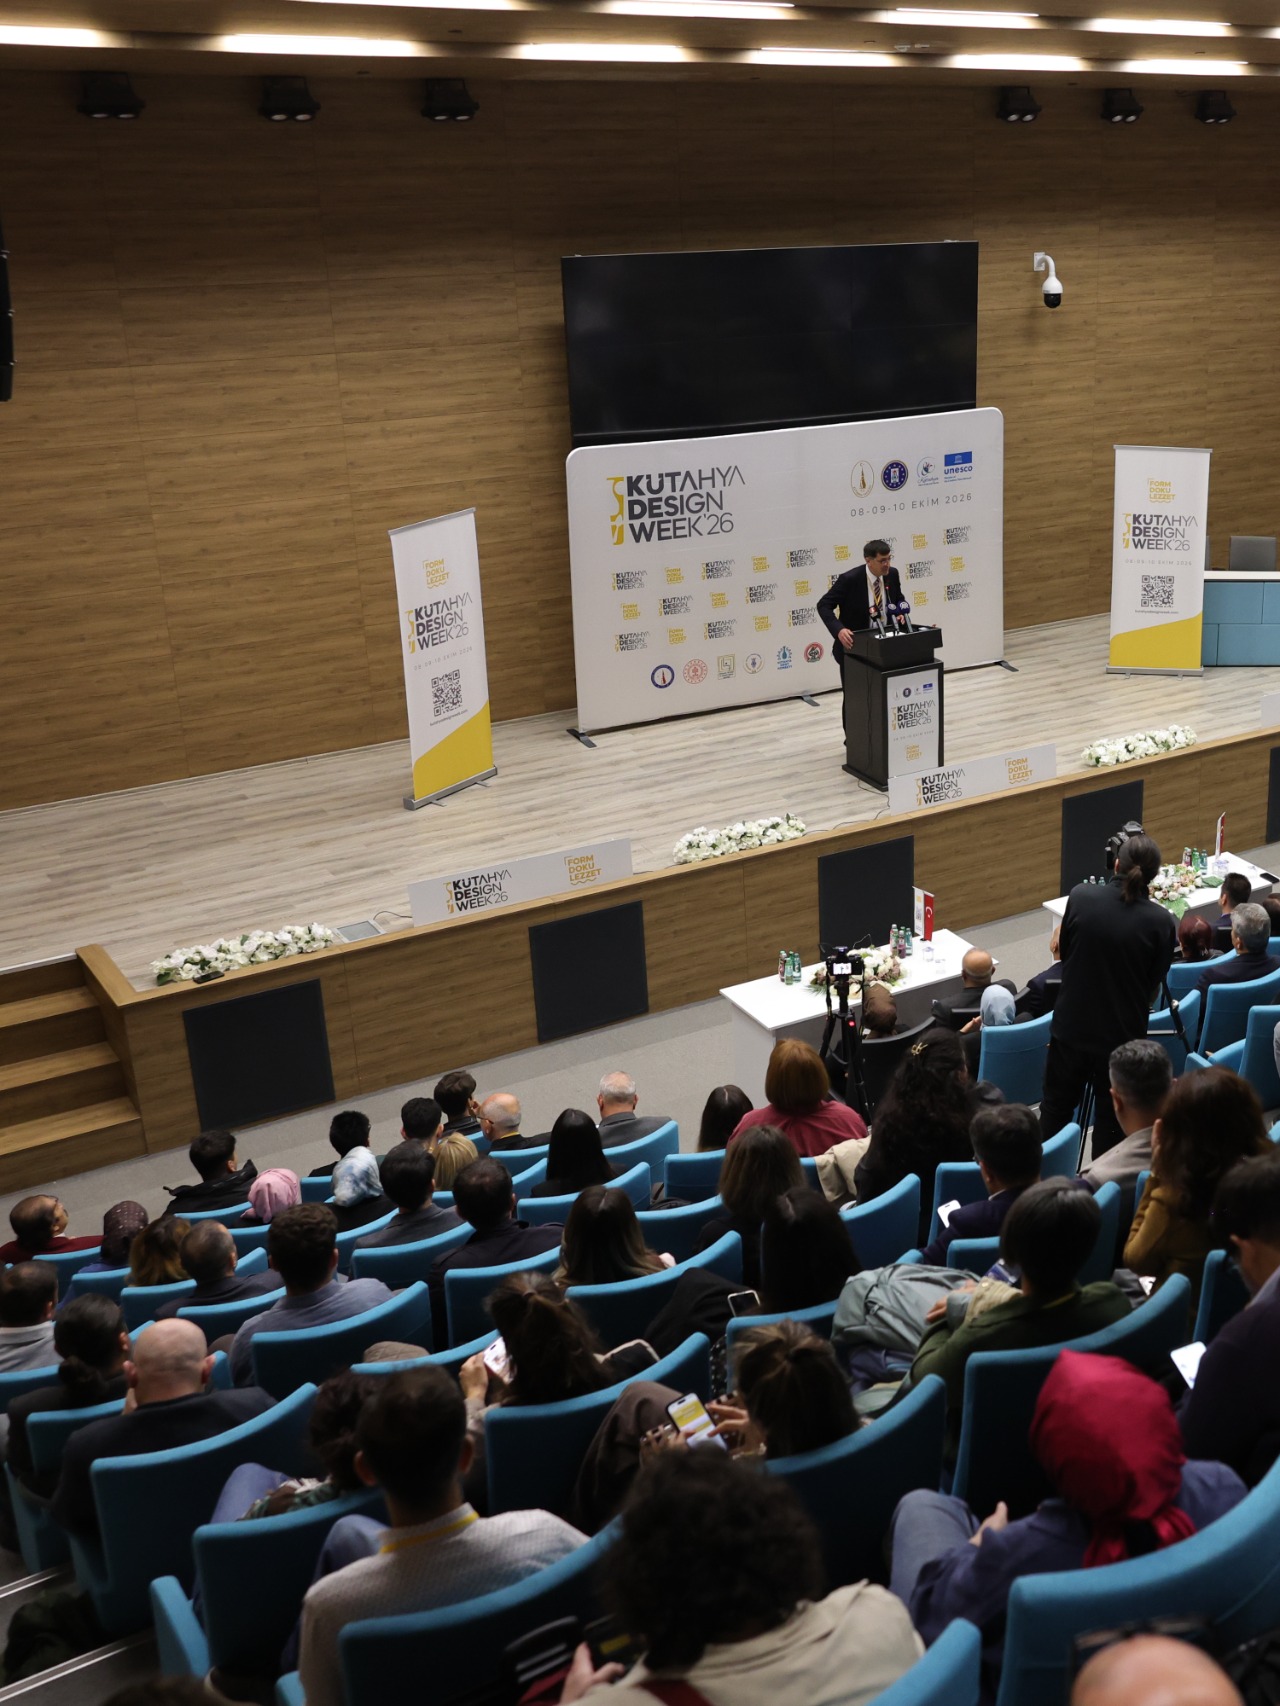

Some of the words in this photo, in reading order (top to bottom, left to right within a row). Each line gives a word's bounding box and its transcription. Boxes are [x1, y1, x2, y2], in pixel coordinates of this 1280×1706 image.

[944, 466, 972, 475] unesco
[628, 490, 723, 520] DESIGN
[850, 503, 905, 517] 08-09-10
[945, 493, 972, 504] 2026
[1132, 527, 1185, 538] DESIGN
[425, 559, 444, 569] FORM
[427, 572, 449, 584] LEZZET
[416, 609, 463, 636] DESIGN
[898, 709, 928, 721] DESIGN
[1008, 758, 1027, 767] FORM
[1008, 764, 1028, 774] DOKU
[1009, 770, 1032, 780] LEZZET
[922, 779, 957, 795] DESIGN
[568, 854, 593, 866] FORM
[569, 863, 594, 873] DOKU
[570, 869, 601, 881] LEZZET
[454, 882, 502, 901] DESIGN
